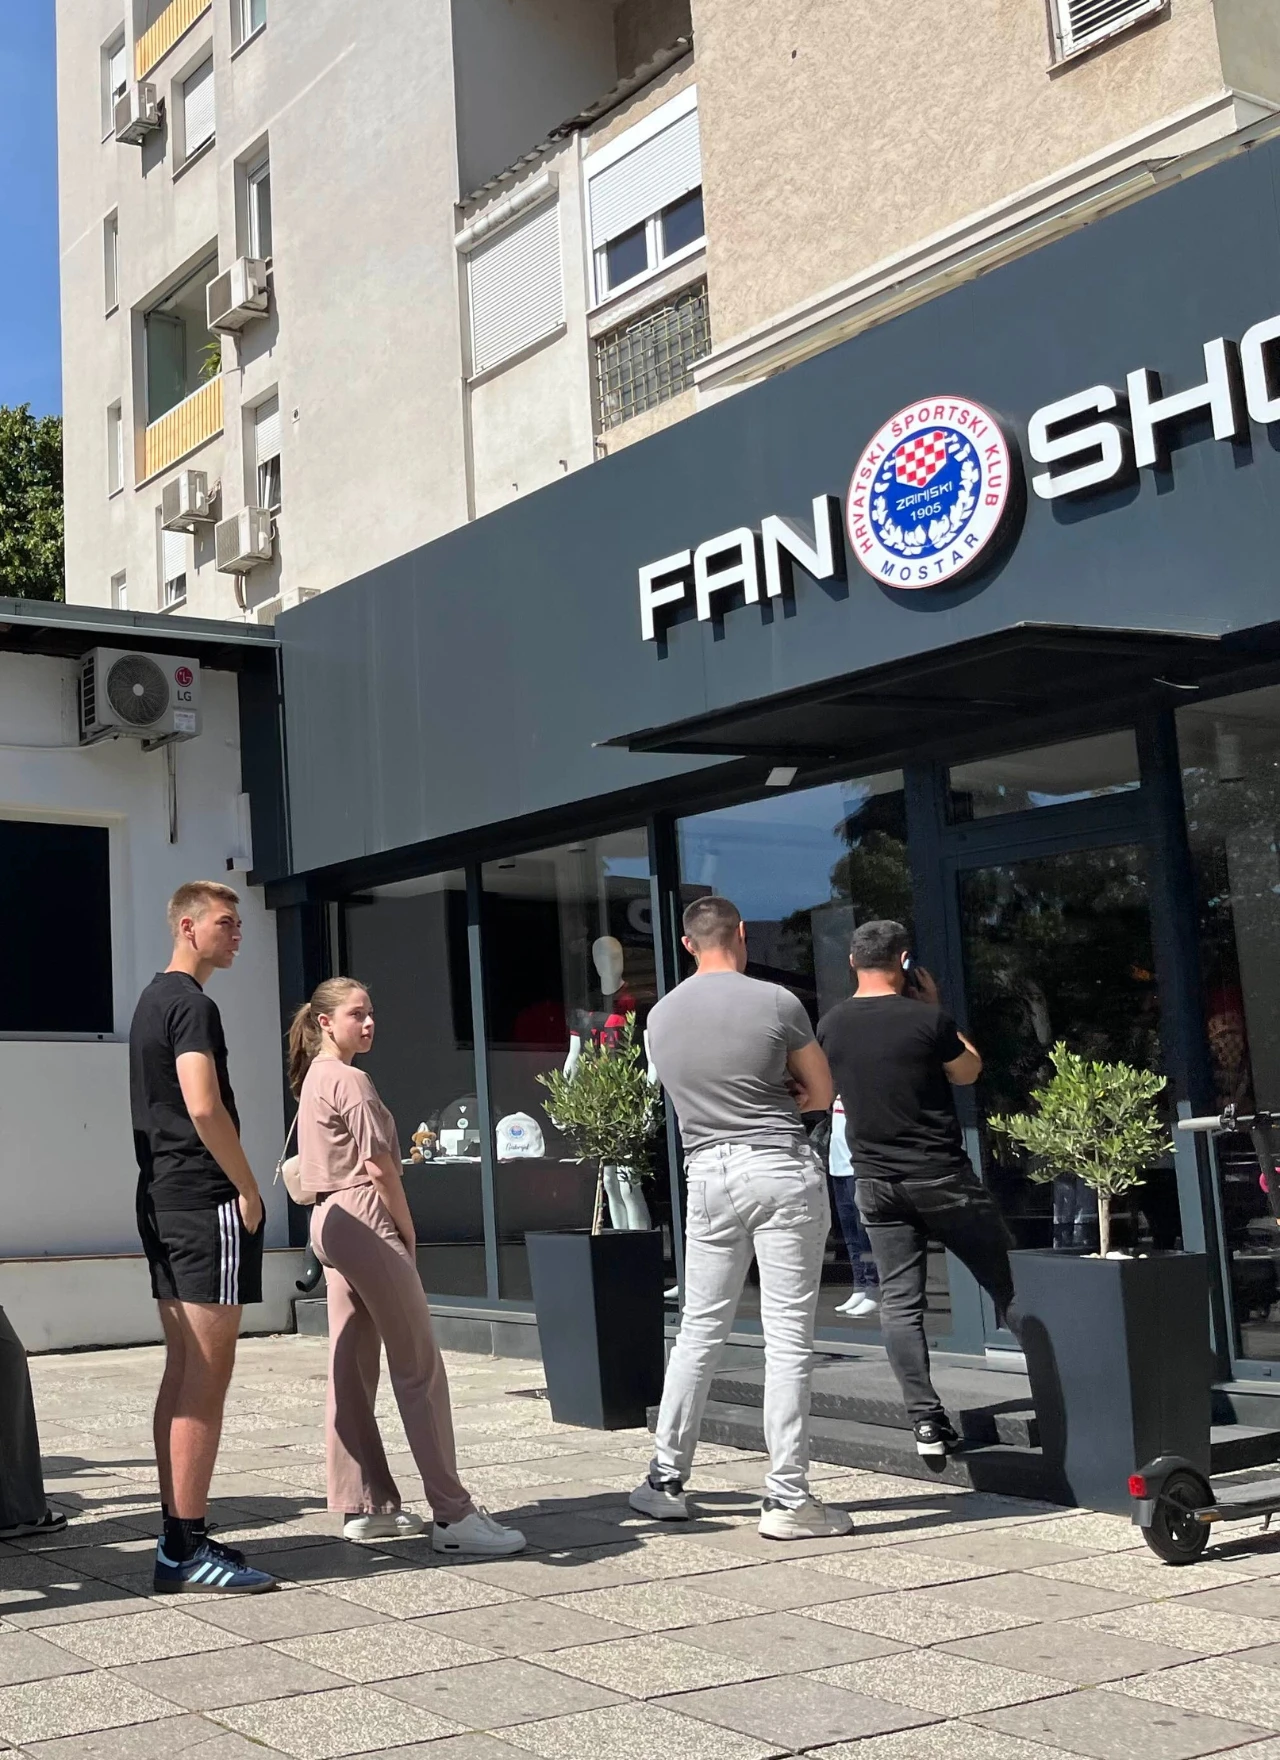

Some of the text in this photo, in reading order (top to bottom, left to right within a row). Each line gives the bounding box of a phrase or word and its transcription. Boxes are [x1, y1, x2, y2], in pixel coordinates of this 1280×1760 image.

[852, 404, 1003, 555] HRVATSKI ŠPORTSKI KLUB
[909, 502, 943, 522] 1905
[638, 494, 836, 642] FAN
[880, 532, 980, 582] MOSTAR
[177, 690, 192, 701] LG
